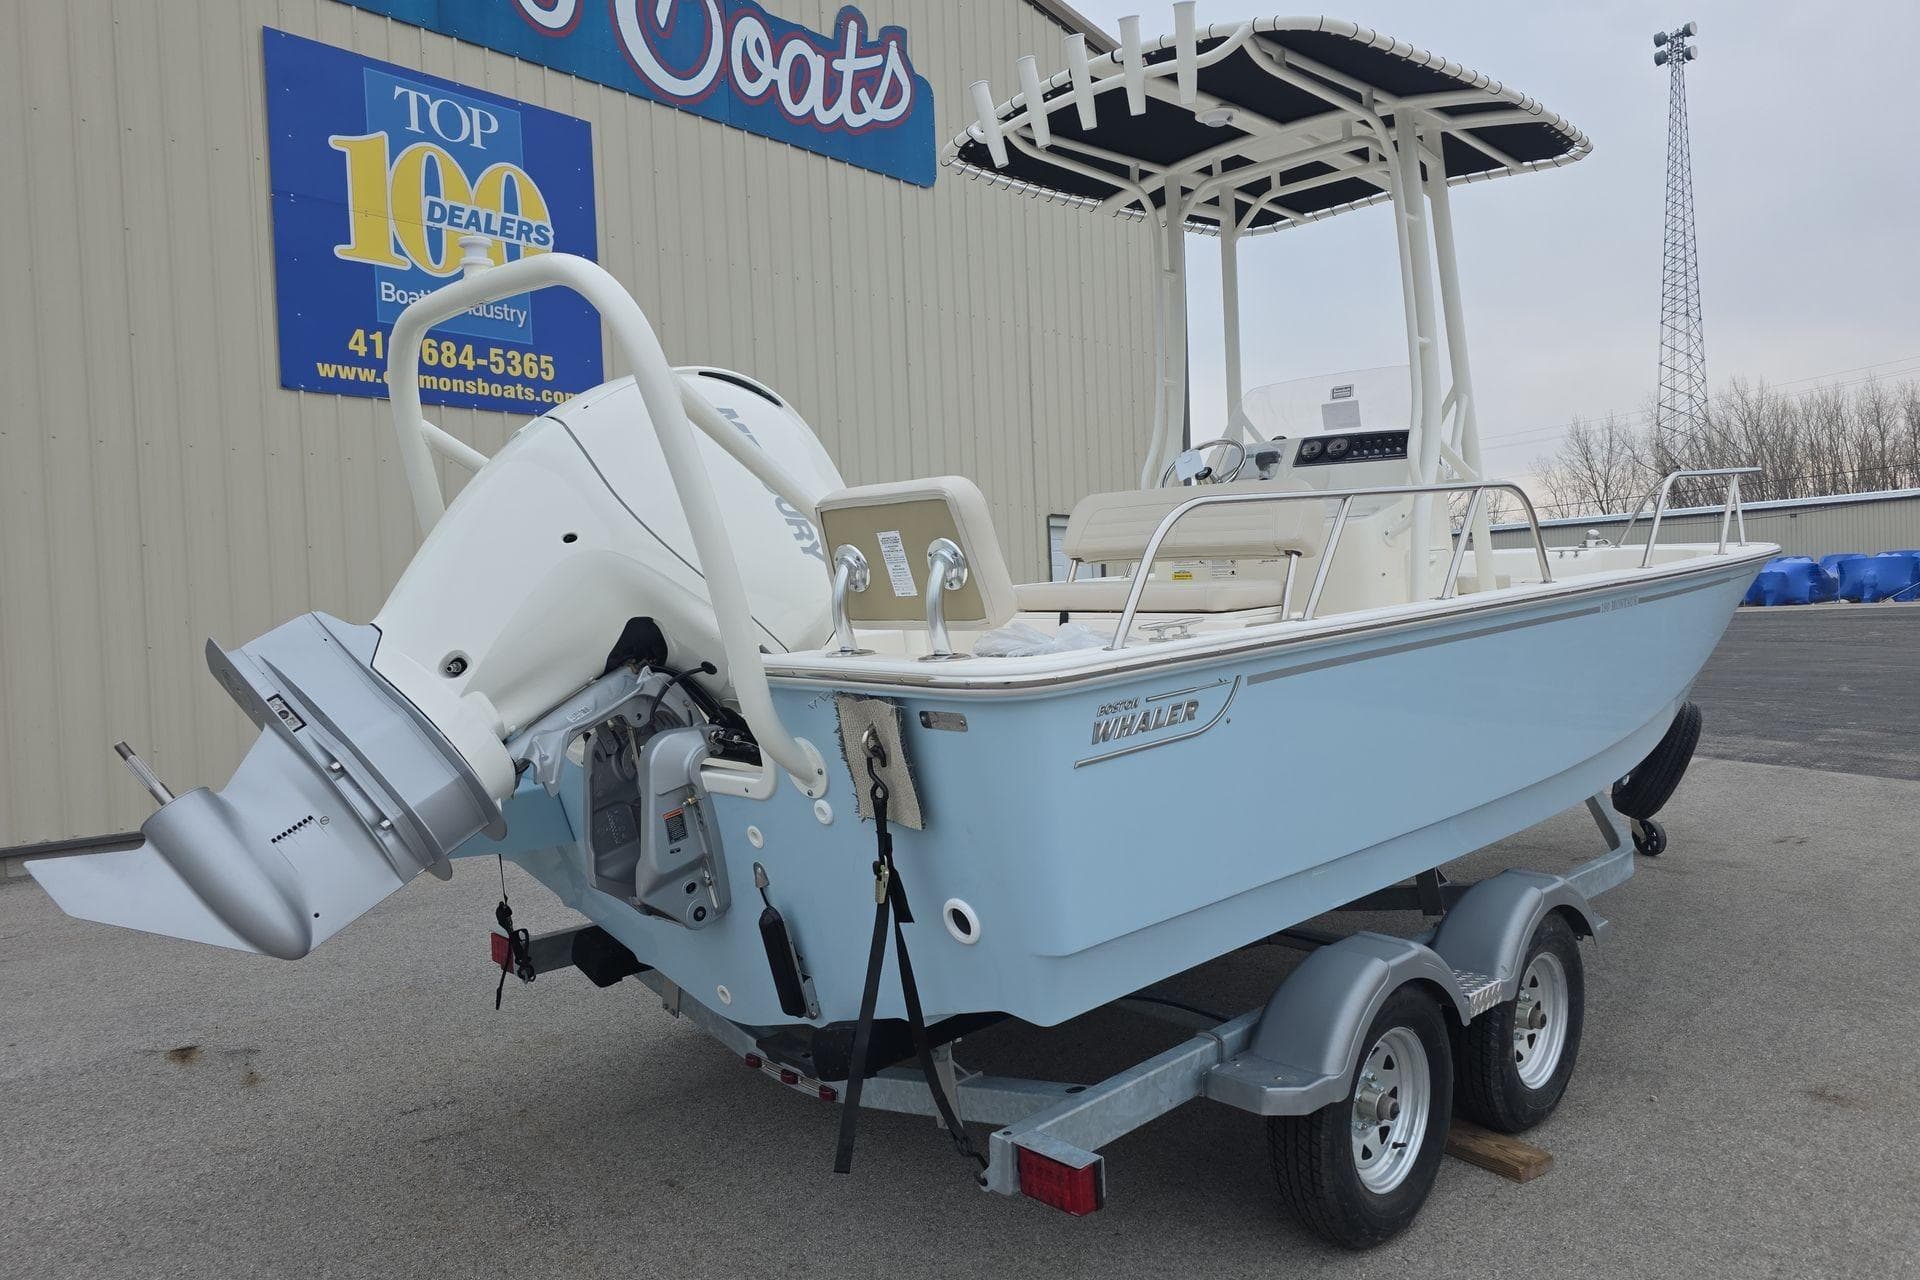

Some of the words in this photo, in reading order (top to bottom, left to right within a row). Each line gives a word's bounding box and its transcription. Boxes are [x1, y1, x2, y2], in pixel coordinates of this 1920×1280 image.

[394, 85, 500, 150] TOP
[328, 130, 554, 277] 100
[426, 200, 551, 247] DEALERS
[468, 303, 527, 328] dustry
[348, 328, 556, 381] 41684-5365
[1091, 699, 1200, 746] WHALER
[1096, 697, 1141, 718] BOSTON
